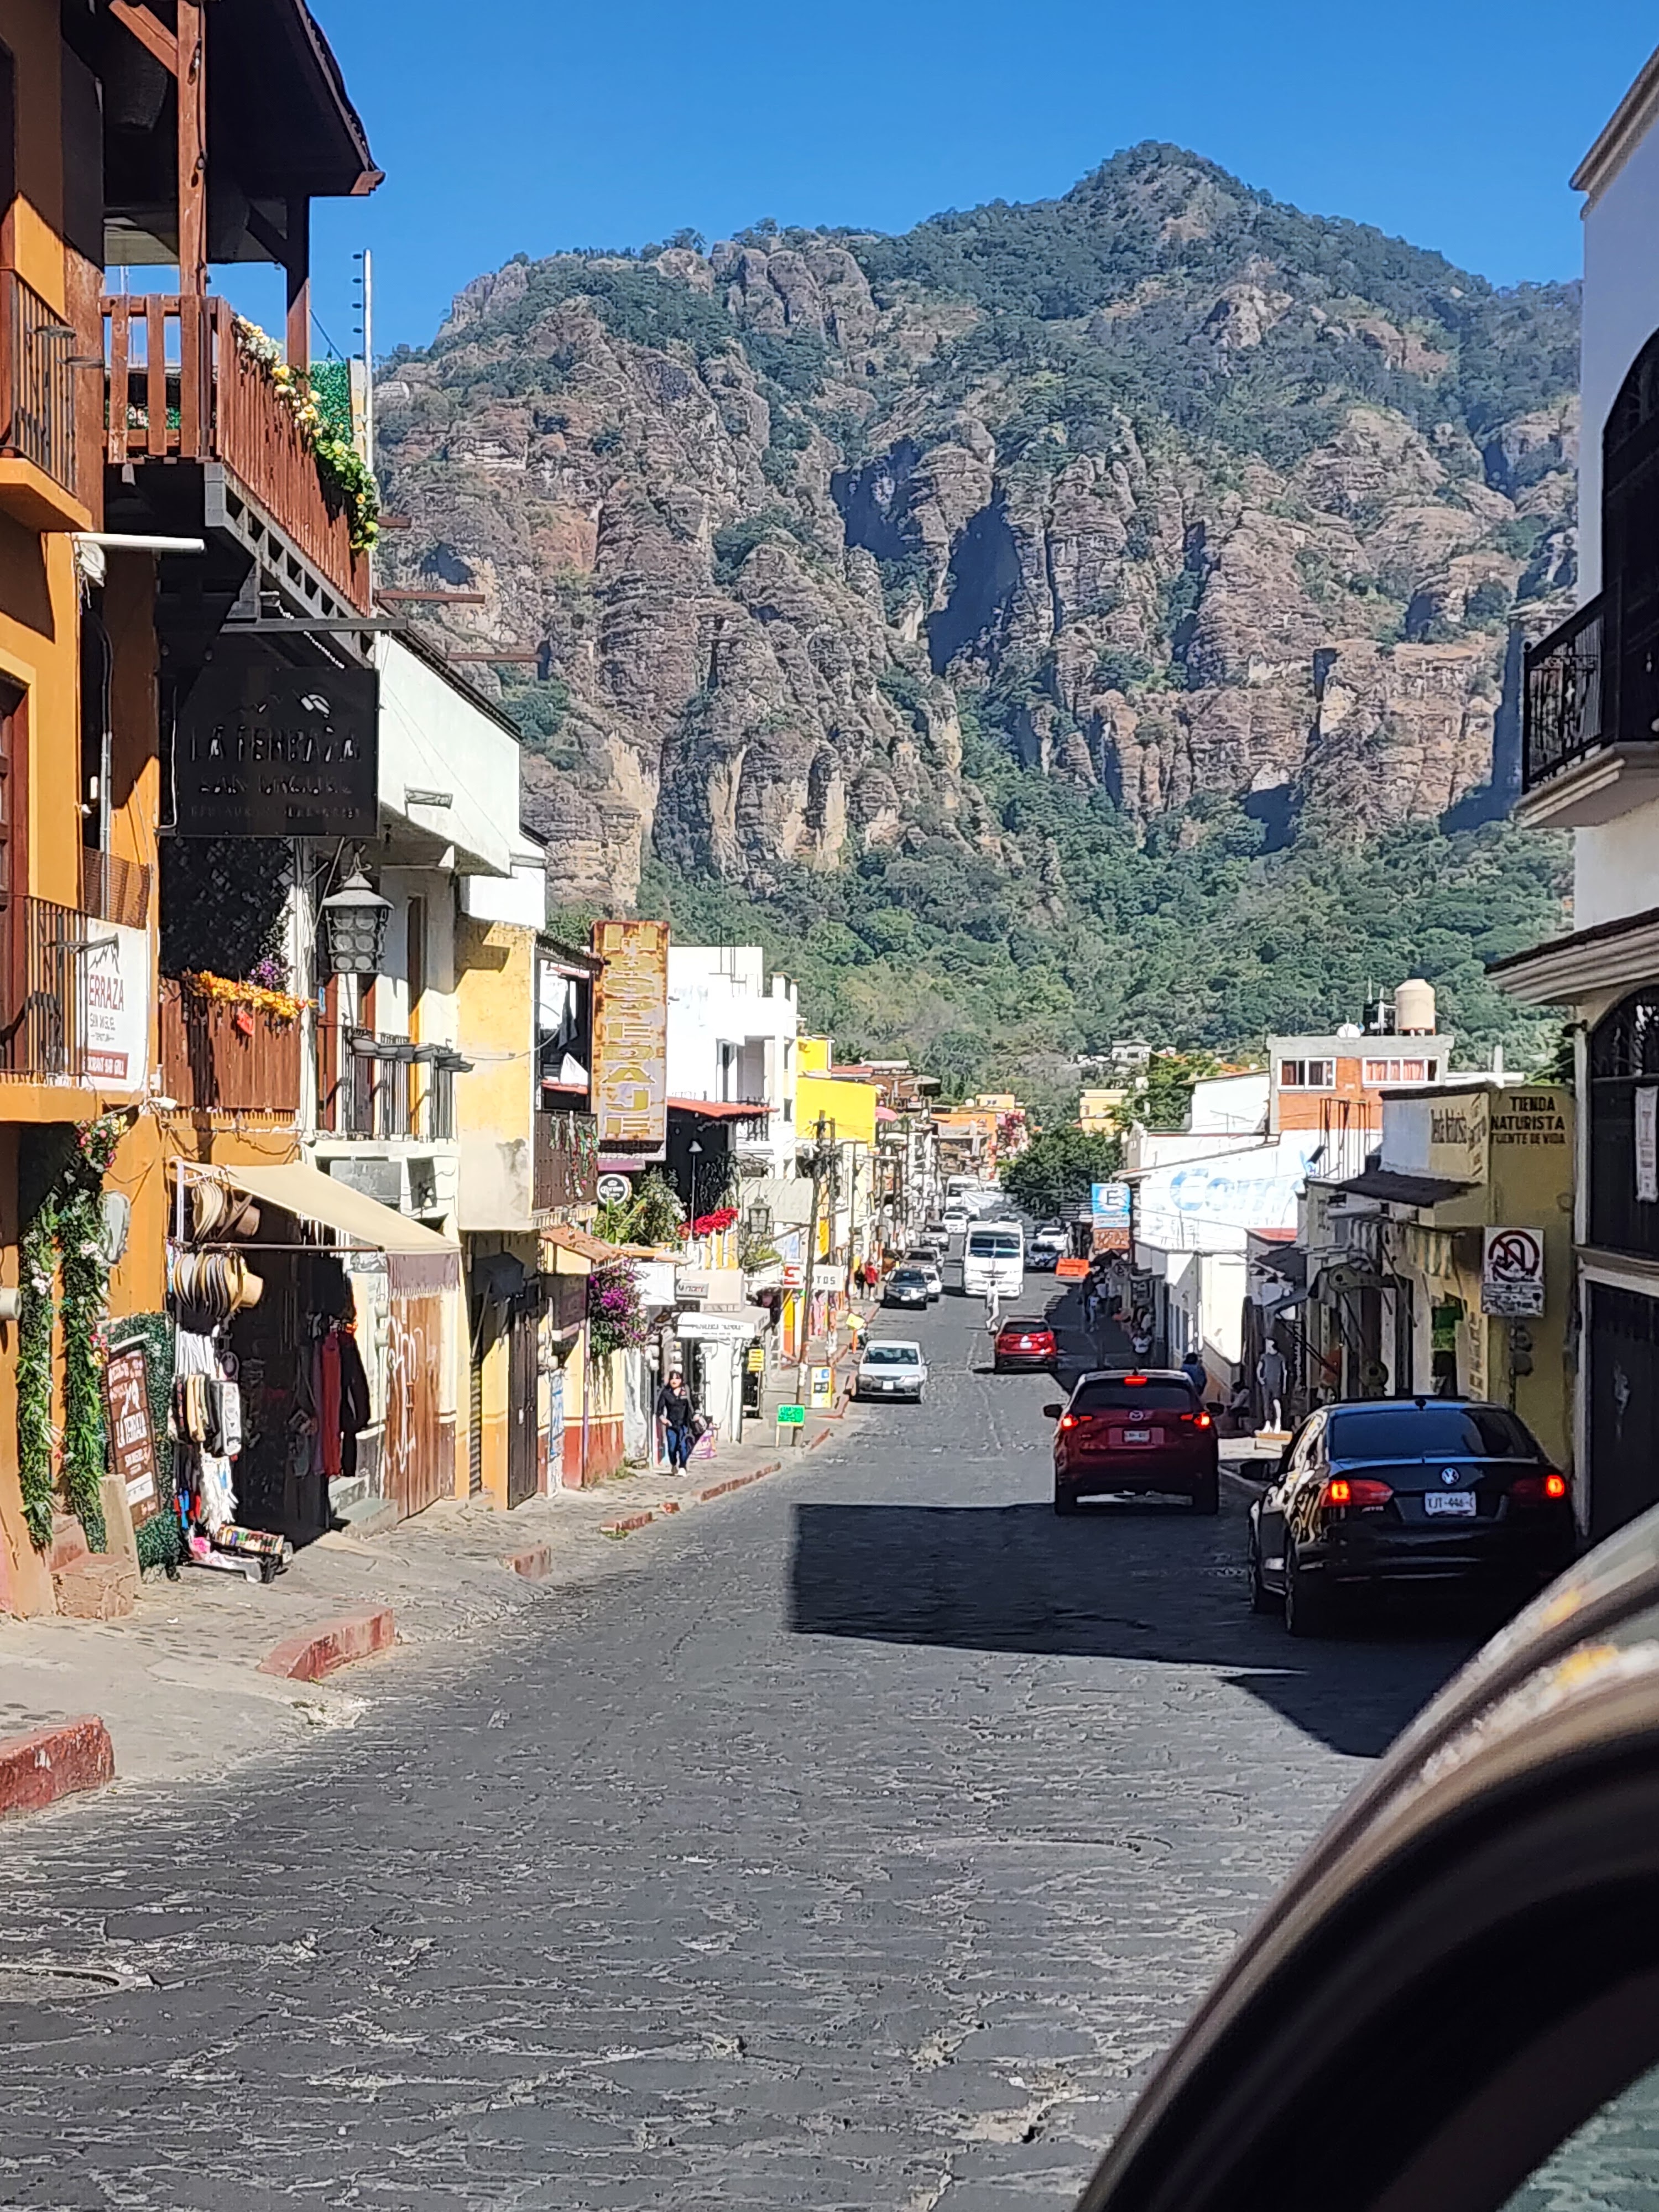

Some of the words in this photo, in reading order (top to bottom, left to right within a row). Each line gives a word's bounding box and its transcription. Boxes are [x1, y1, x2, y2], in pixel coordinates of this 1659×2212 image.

[88, 974, 124, 1011] ERRAZA
[600, 922, 660, 1135] HOSPEDAJE
[1509, 1096, 1556, 1112] TIENDA
[1490, 1115, 1566, 1130] NATURISTA
